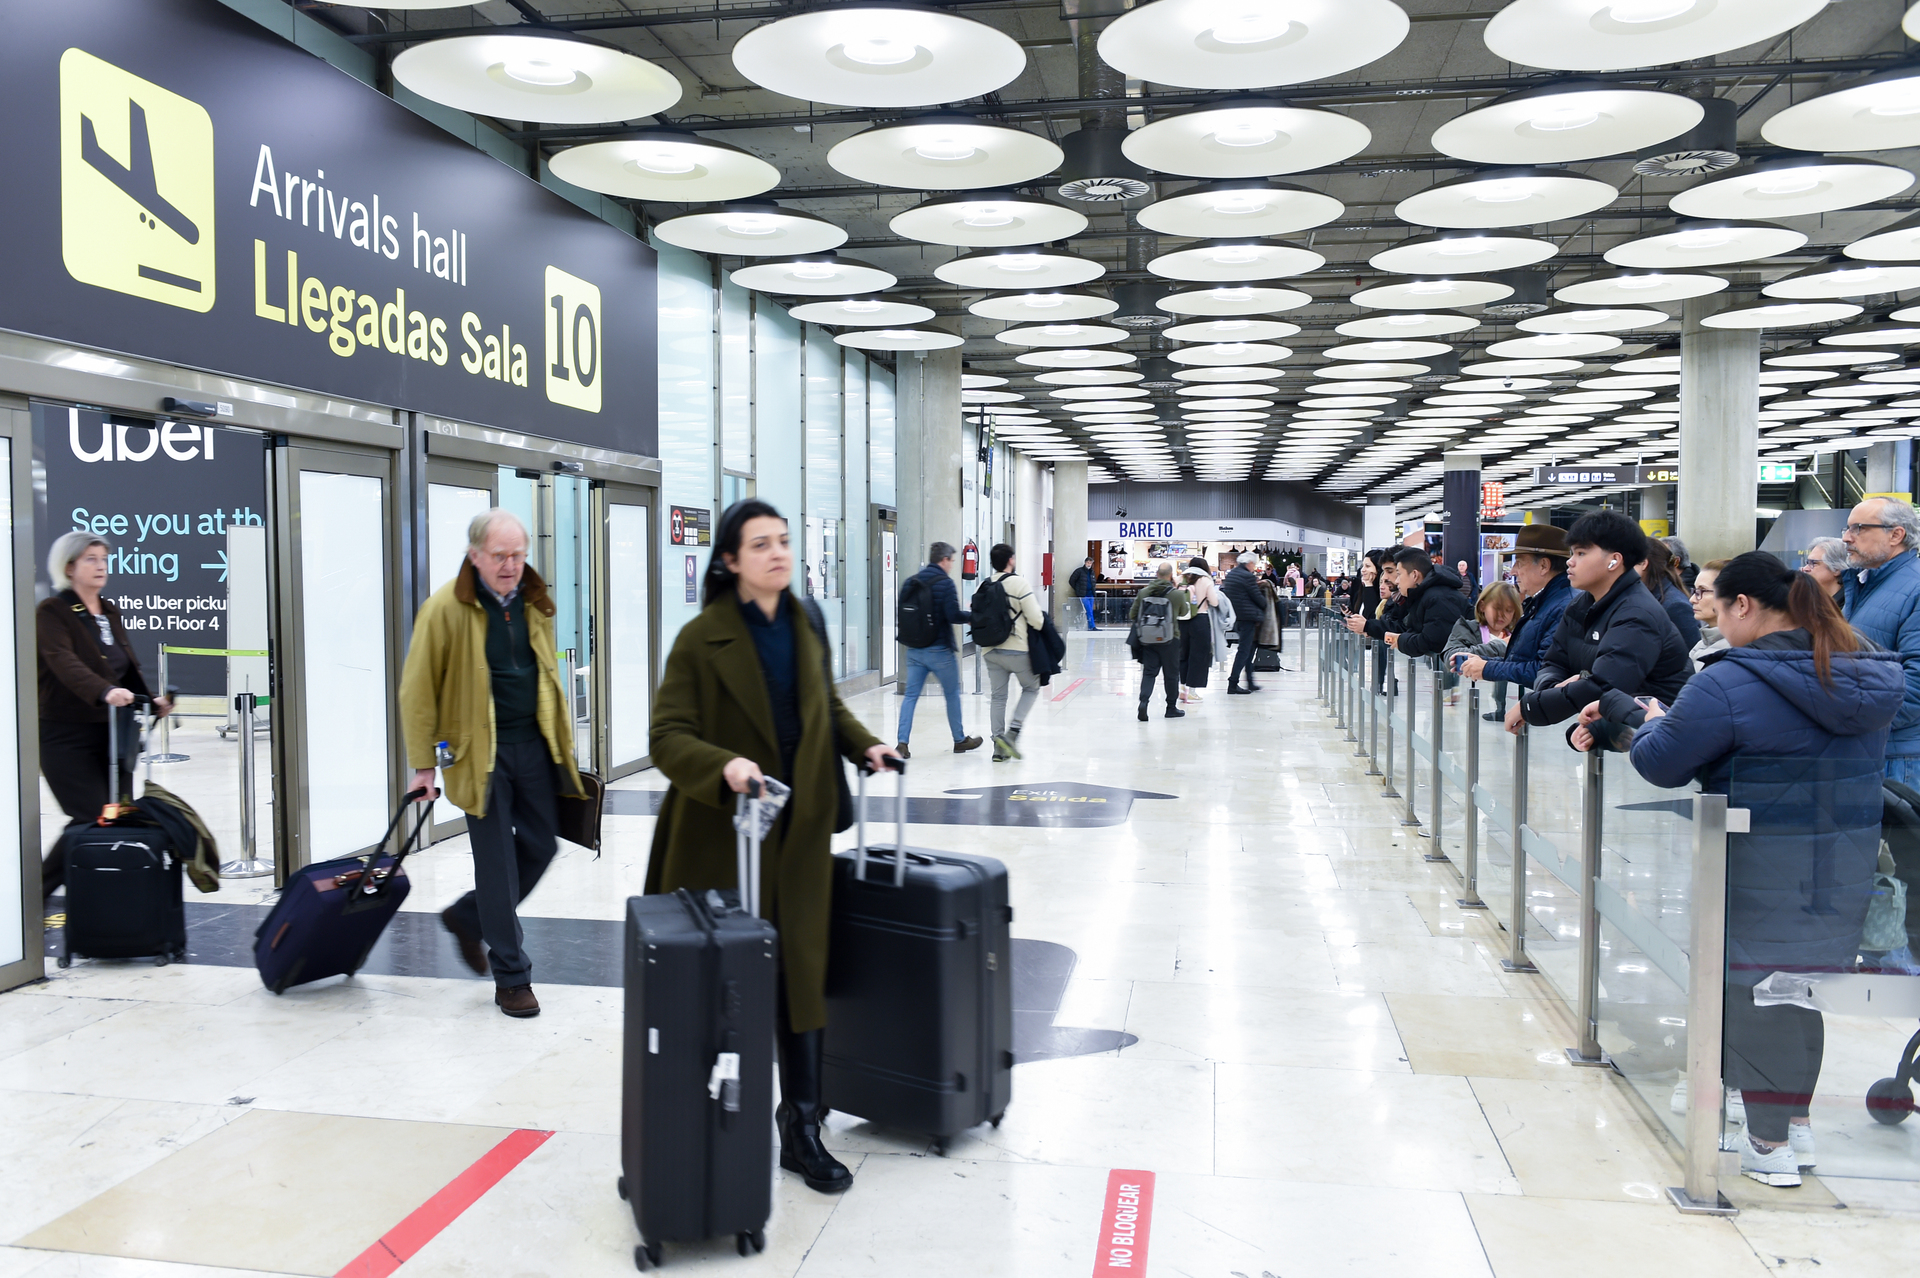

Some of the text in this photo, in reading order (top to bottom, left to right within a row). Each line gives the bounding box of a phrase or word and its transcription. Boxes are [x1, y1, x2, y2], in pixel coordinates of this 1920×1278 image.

[249, 144, 468, 287] Arrivals hall
[255, 239, 529, 388] Llegadas Sala
[550, 294, 598, 388] 10
[71, 506, 265, 543] See you at th
[1119, 522, 1173, 538] BARETO
[106, 546, 179, 582] rking
[118, 595, 143, 610] the
[146, 595, 183, 610] Uber
[186, 595, 227, 614] picku
[149, 615, 165, 630] D.
[167, 615, 206, 631] Floor
[208, 616, 220, 631] 4
[1008, 795, 1107, 803] Salida
[1108, 1184, 1141, 1268] NO BLOQUEAR
